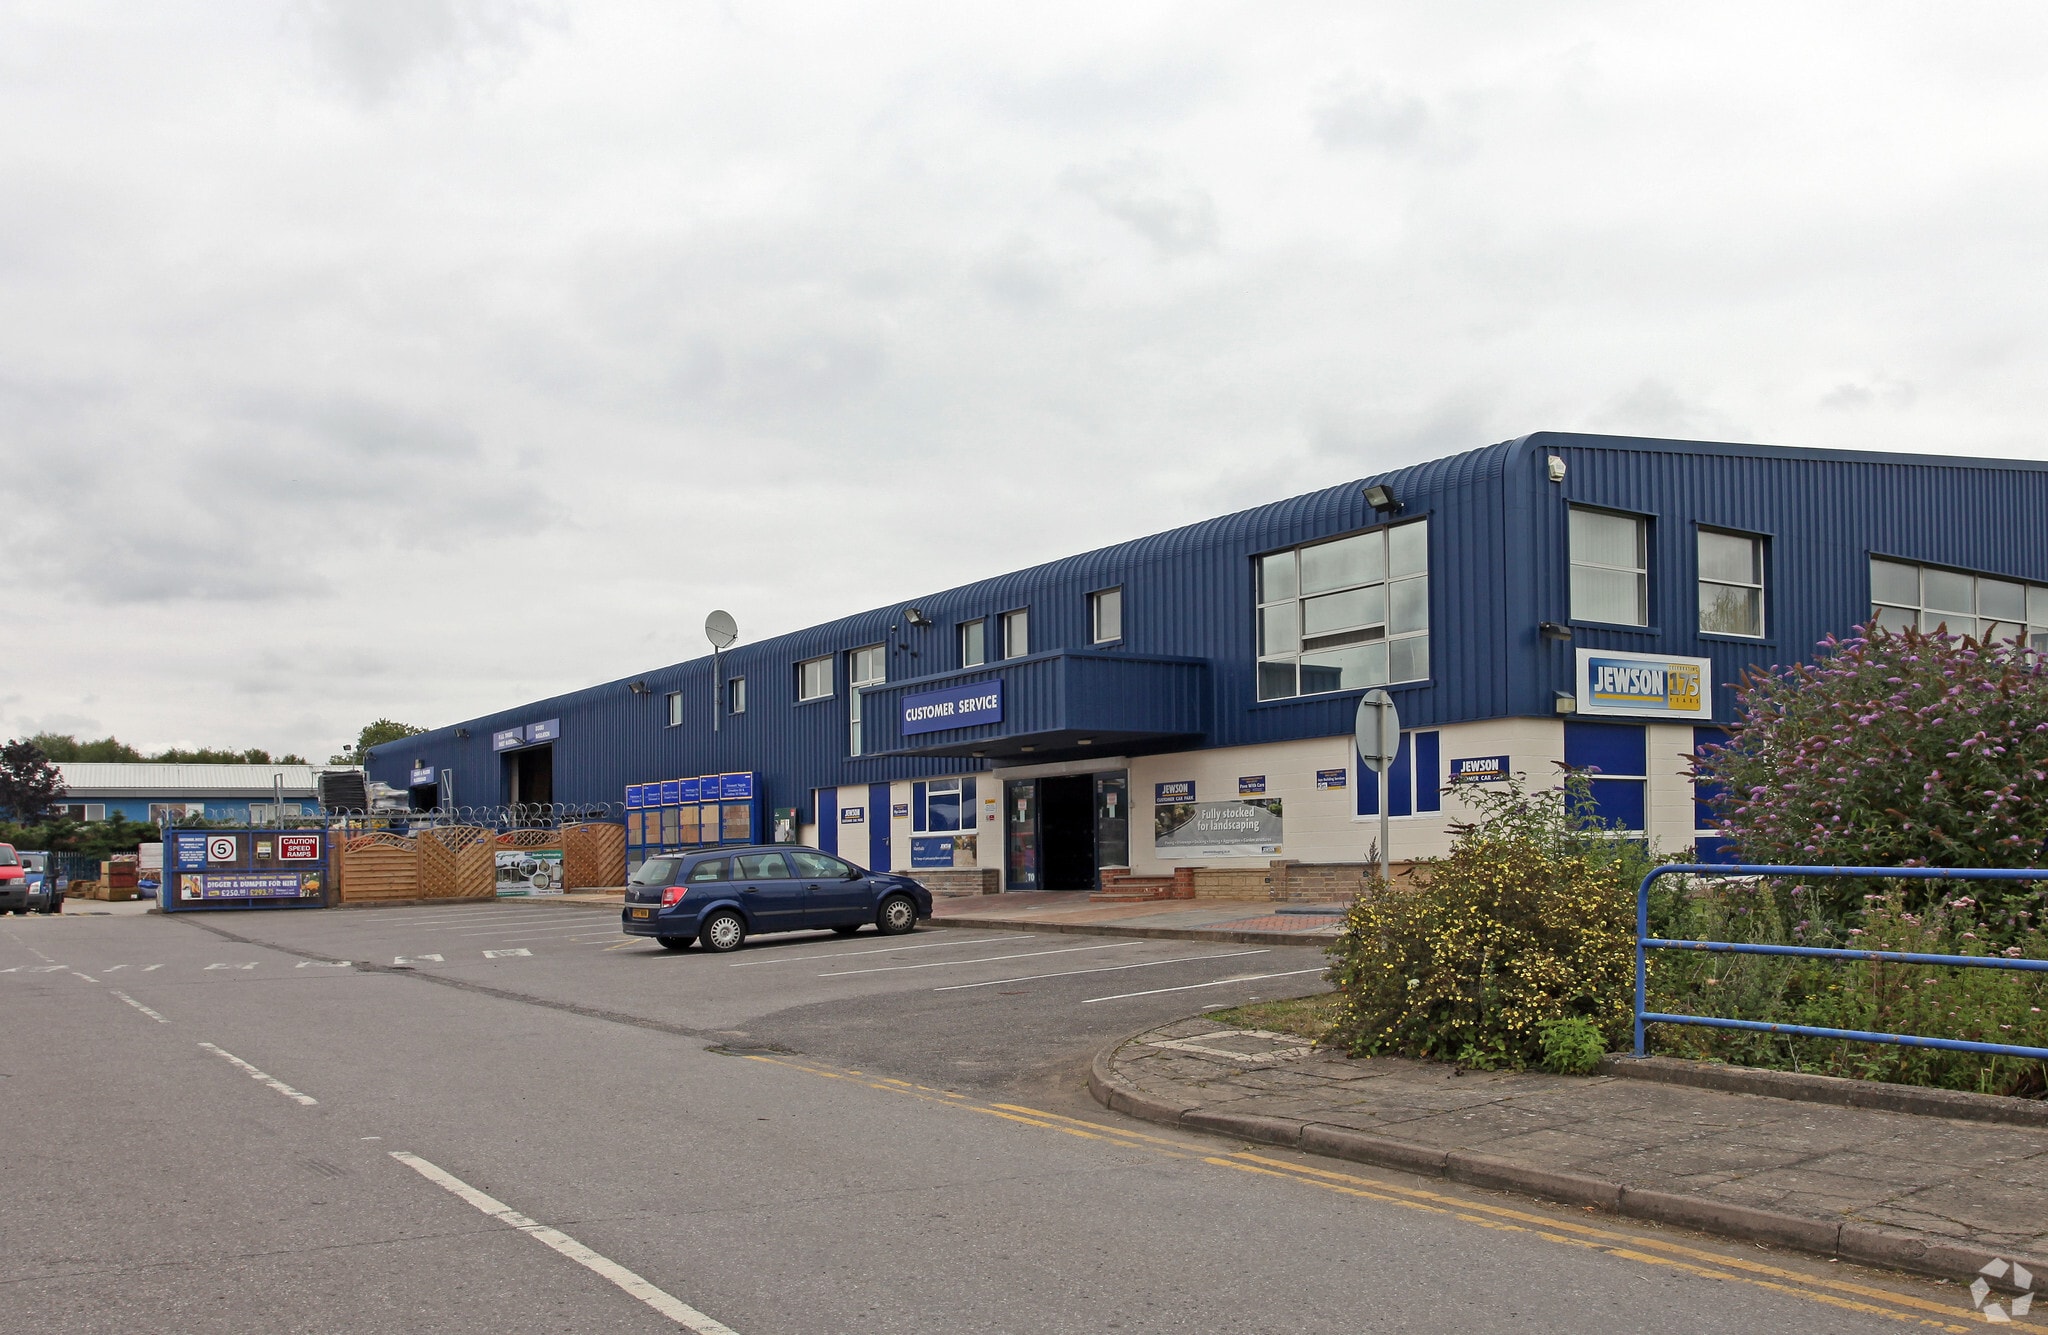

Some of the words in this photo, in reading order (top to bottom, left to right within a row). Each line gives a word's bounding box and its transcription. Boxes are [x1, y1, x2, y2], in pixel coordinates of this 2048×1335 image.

[1594, 666, 1664, 695] JEWSON
[1669, 672, 1699, 697] 175
[905, 702, 954, 722] CUSTOMER
[959, 694, 998, 714] SERVICE
[1461, 759, 1499, 772] JEWSON
[1162, 783, 1188, 794] JEWSON
[1201, 808, 1221, 821] Fully
[1223, 806, 1255, 818] stocked
[1197, 821, 1209, 831] for
[1210, 819, 1260, 833] landscaping
[217, 843, 227, 855] 5
[282, 879, 298, 887] HIRE
